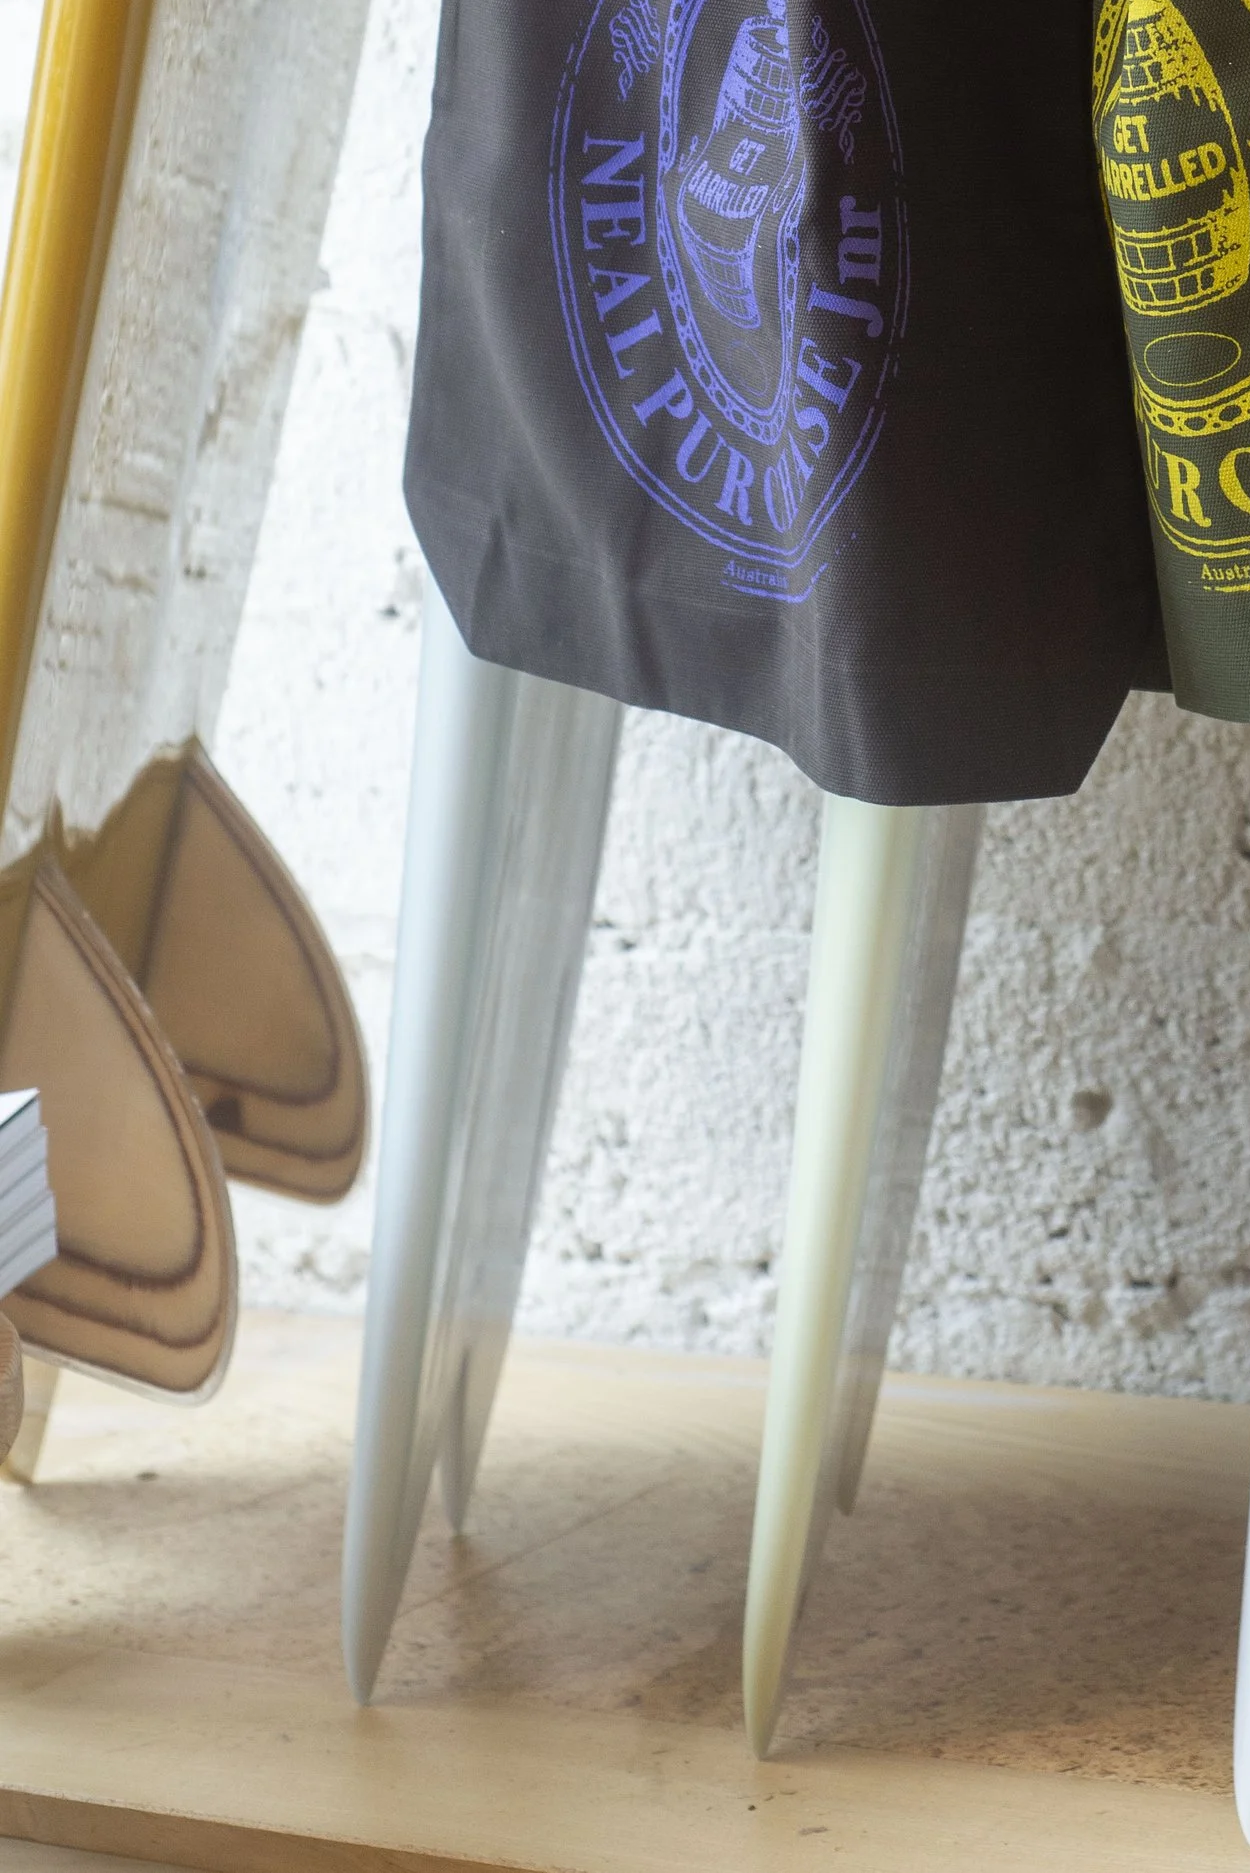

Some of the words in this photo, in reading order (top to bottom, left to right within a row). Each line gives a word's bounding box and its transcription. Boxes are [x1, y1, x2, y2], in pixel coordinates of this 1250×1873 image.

[728, 136, 767, 176] GET
[1113, 114, 1150, 154] GET
[1102, 141, 1228, 202] ARRELLED
[581, 132, 663, 380] NEAL
